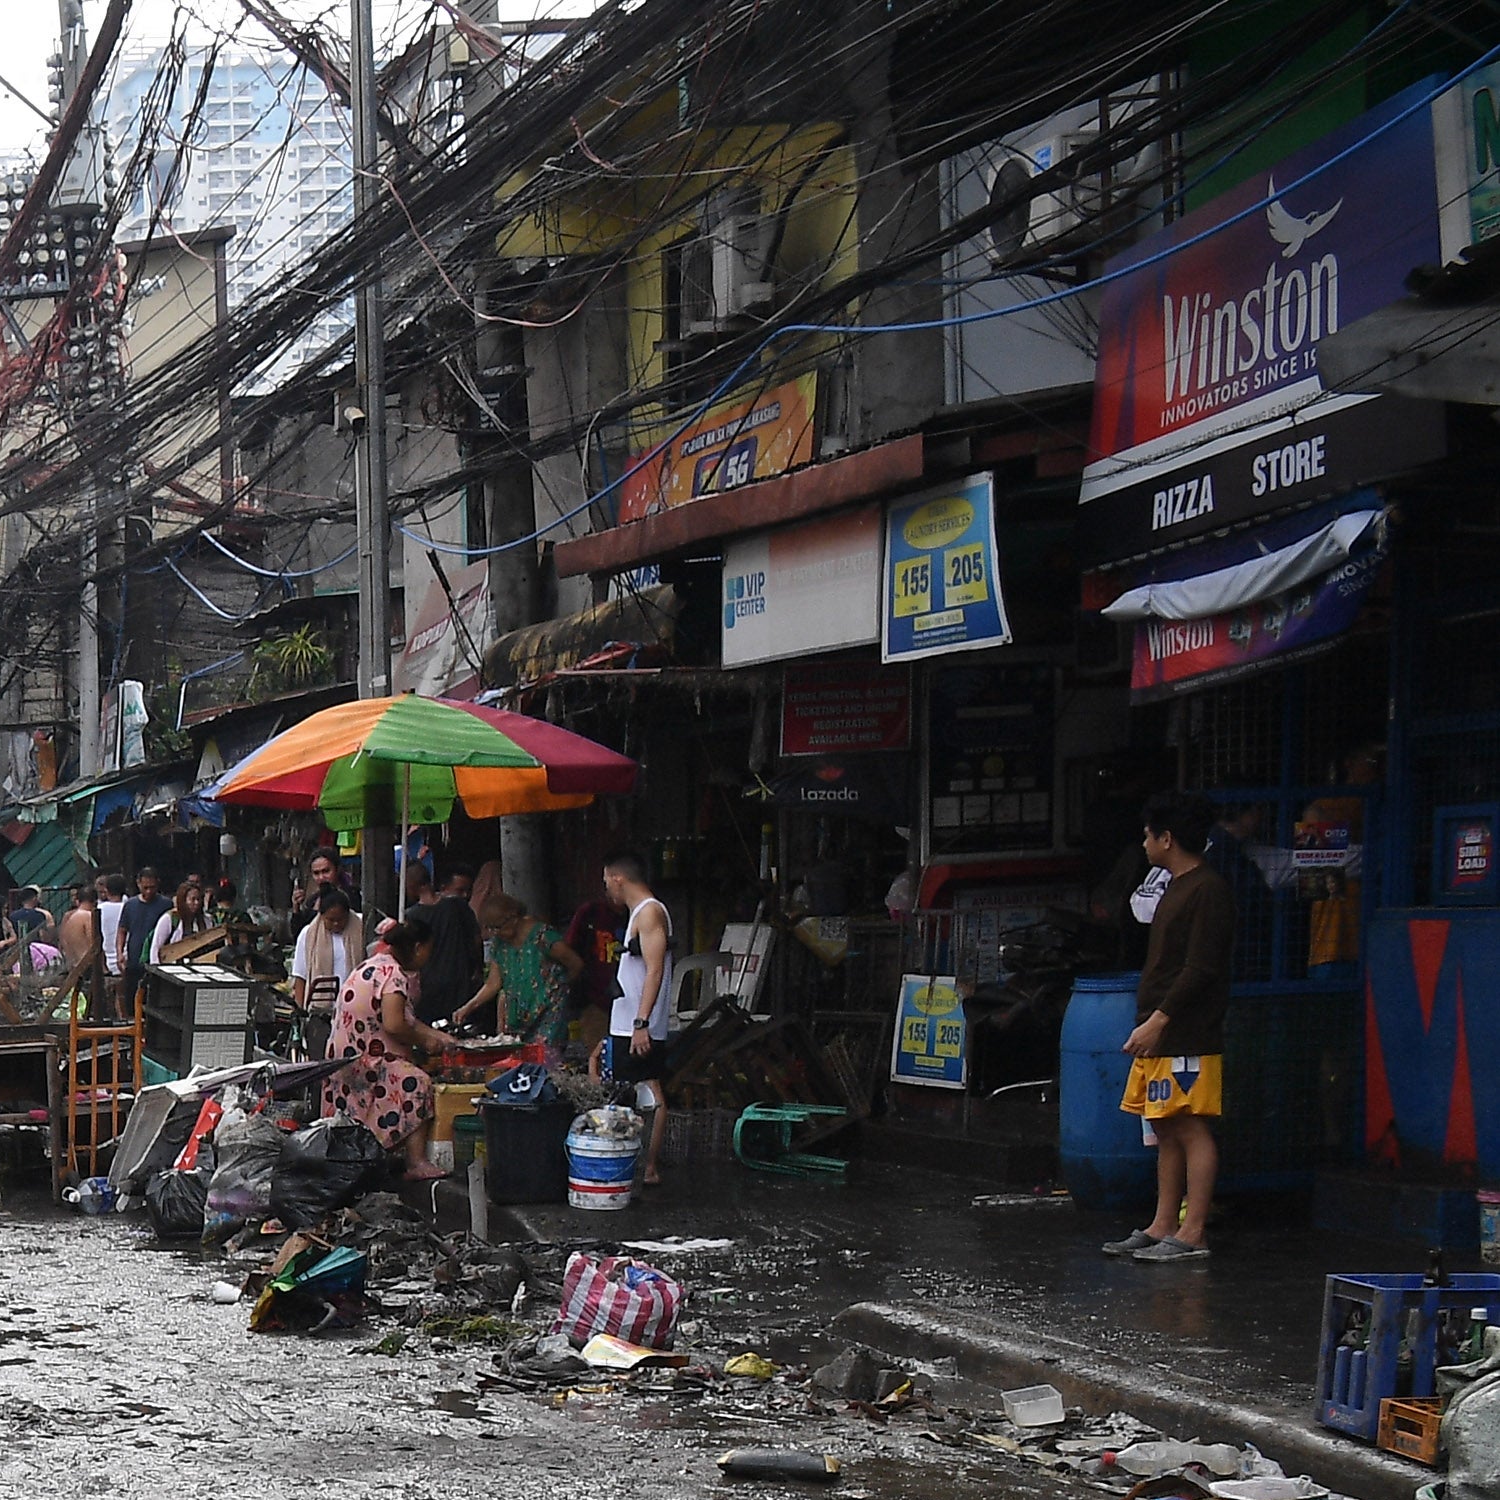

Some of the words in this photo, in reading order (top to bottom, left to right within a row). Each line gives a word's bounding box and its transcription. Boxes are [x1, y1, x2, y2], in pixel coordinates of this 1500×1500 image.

[1163, 253, 1338, 402] Winston
[1161, 375, 1248, 428] INNOVATORS
[1254, 355, 1298, 388] SINCE
[1152, 474, 1214, 531] RIZZA
[1251, 435, 1326, 496] STORE
[746, 572, 765, 597] VIP
[901, 564, 929, 597] 155
[951, 552, 984, 587] 205
[736, 597, 765, 618] CENTER
[1147, 619, 1213, 661] Winston
[808, 733, 856, 746] AVAILABLE
[908, 1023, 926, 1041] 155
[940, 1026, 960, 1044] 205
